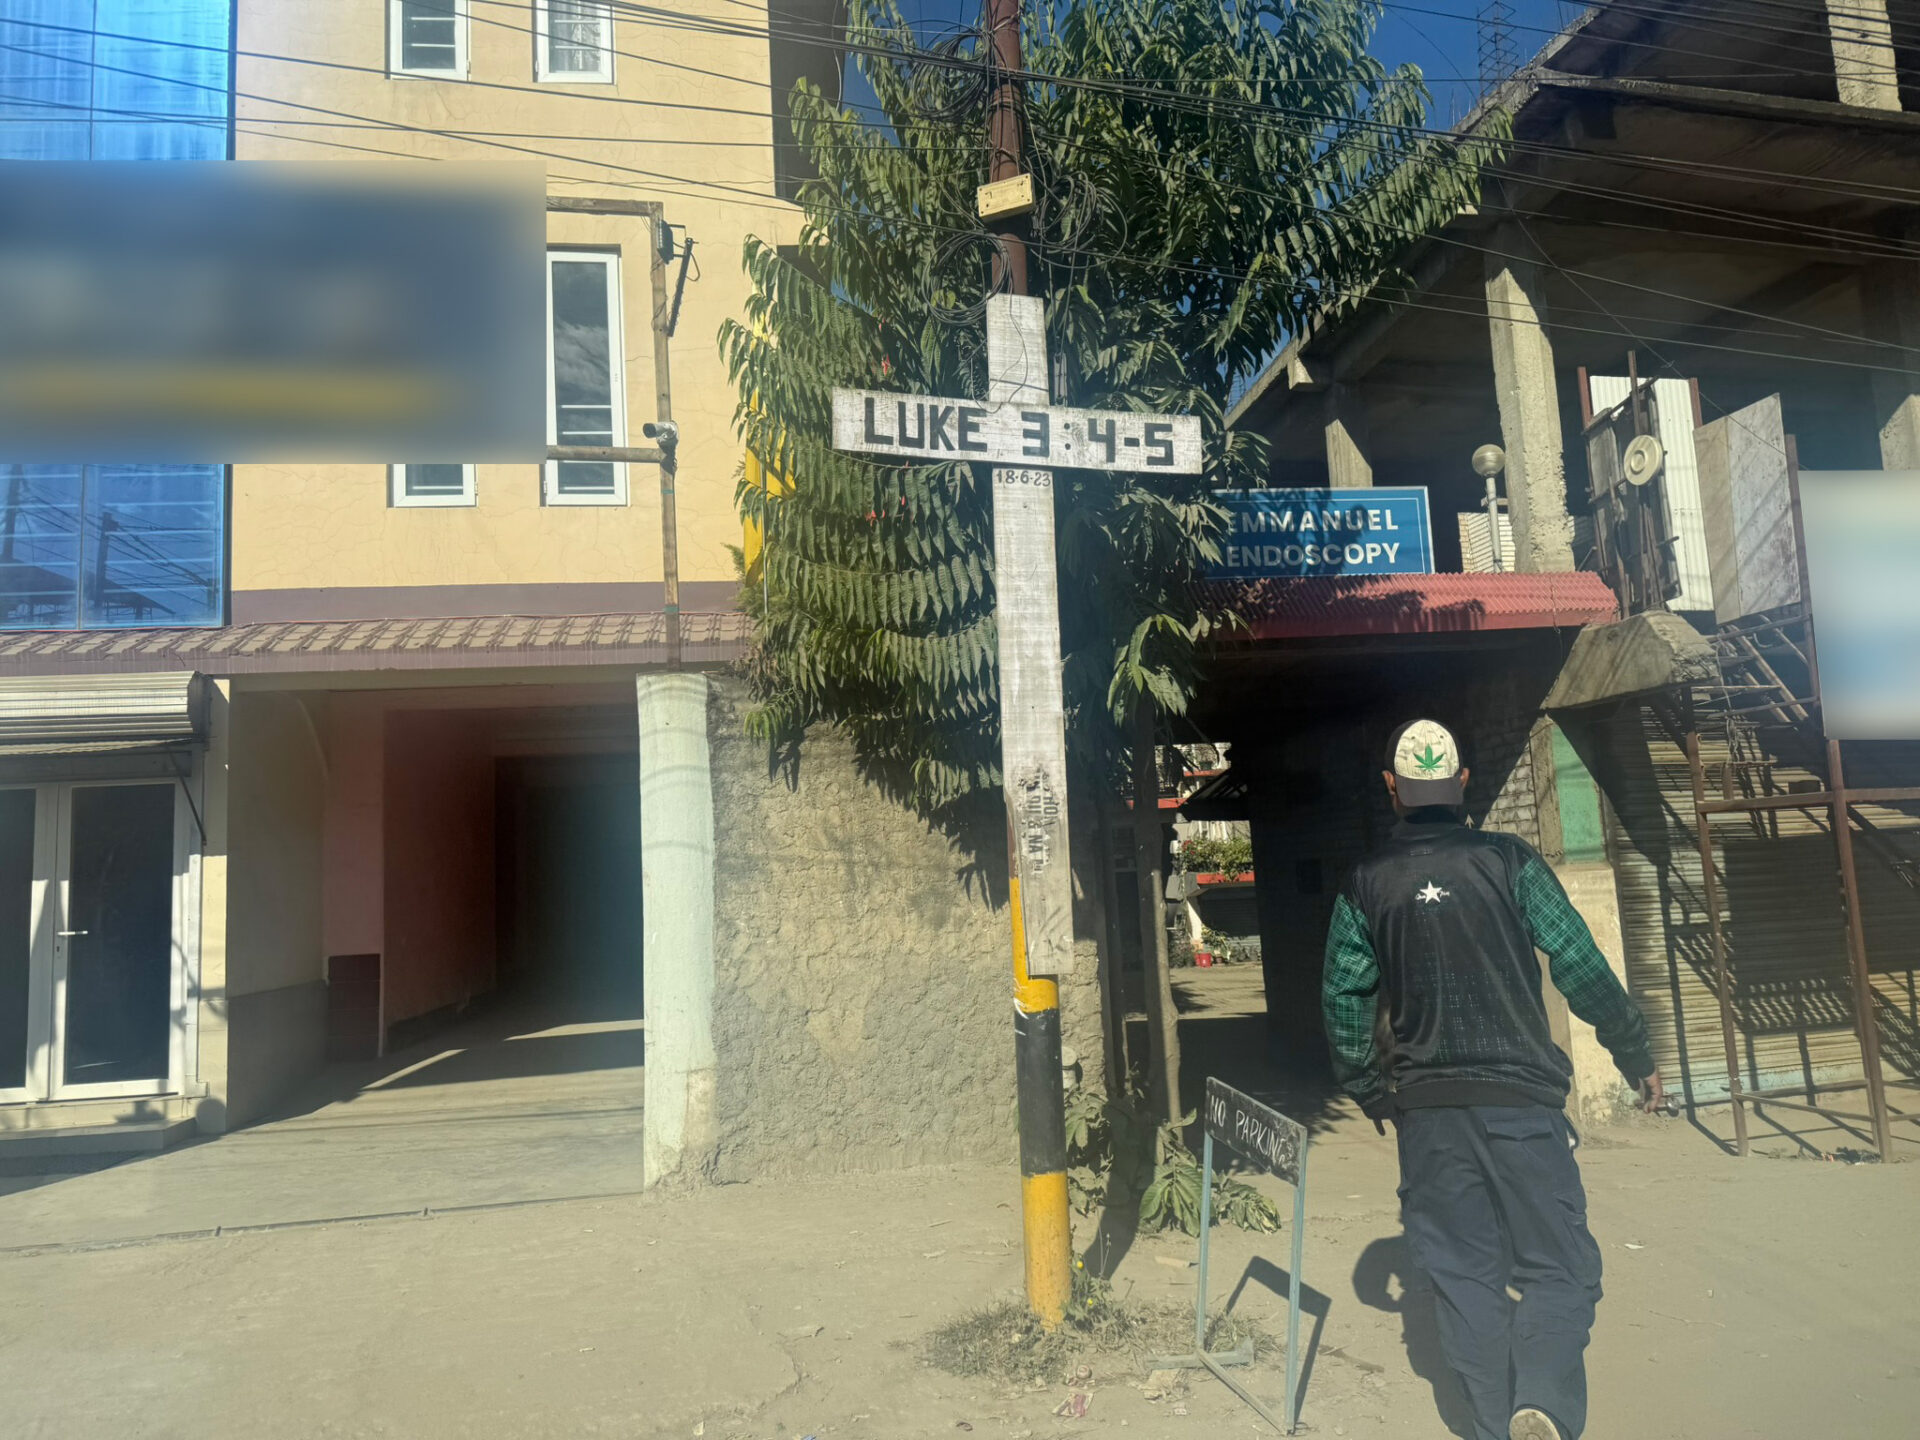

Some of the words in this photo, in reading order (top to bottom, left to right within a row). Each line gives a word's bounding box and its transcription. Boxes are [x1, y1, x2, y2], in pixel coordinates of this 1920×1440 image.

[864, 397, 988, 453] LUKE
[1227, 543, 1400, 567] ENDOSCOPY
[1210, 1095, 1226, 1127] NO
